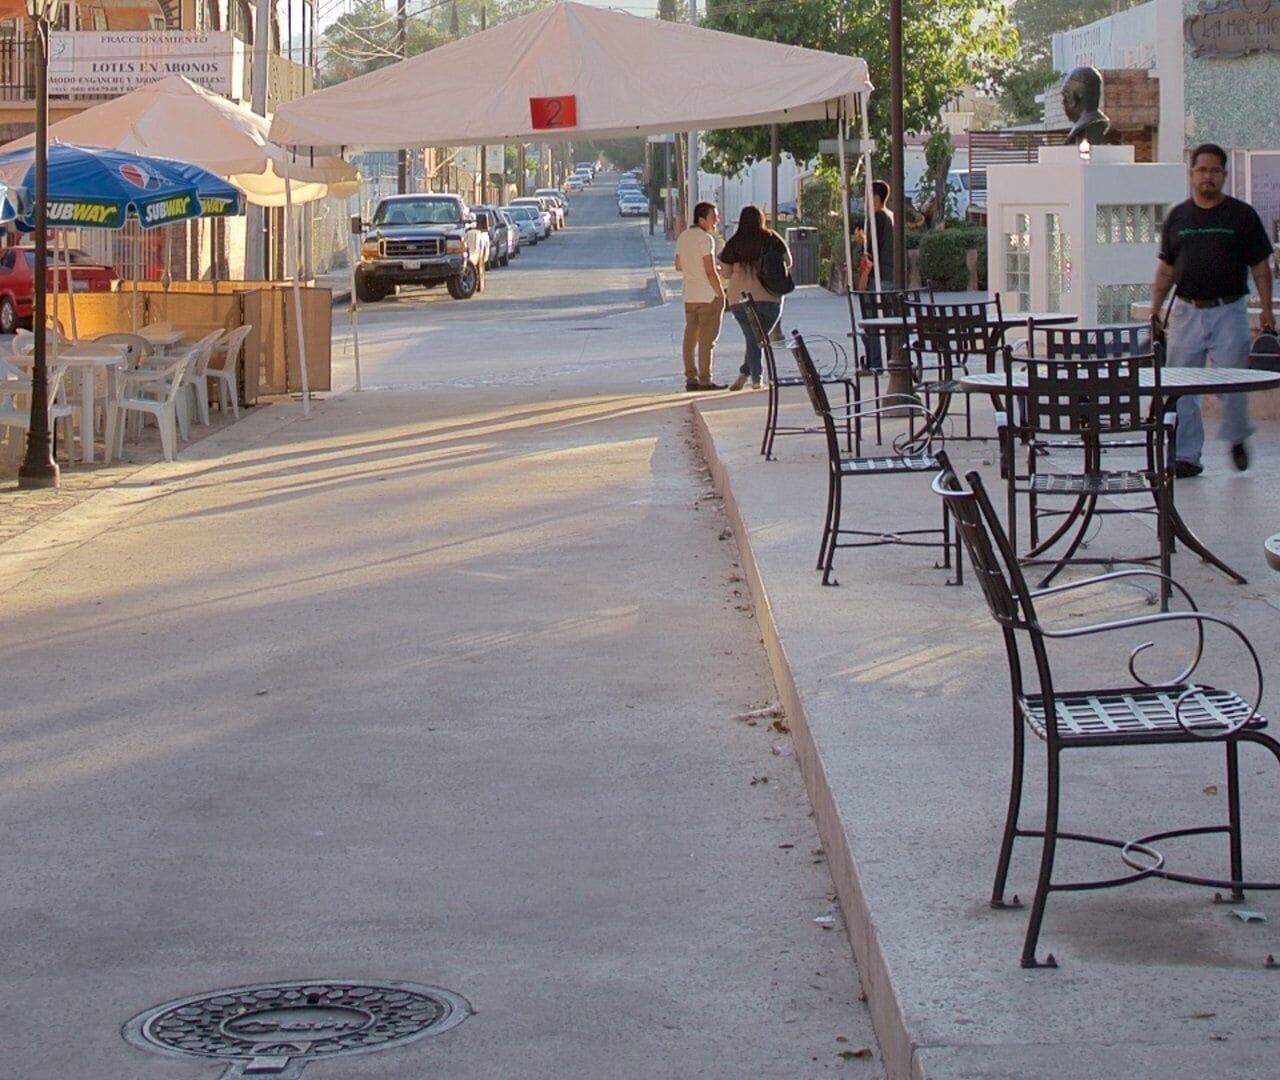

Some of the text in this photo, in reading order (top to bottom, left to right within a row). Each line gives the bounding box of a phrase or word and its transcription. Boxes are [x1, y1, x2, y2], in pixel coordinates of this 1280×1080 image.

[1201, 18, 1221, 39] LA
[100, 35, 209, 44] FRACCIONAMIENTO
[91, 62, 219, 74] LOTES EN ABONOS
[545, 99, 564, 127] 2
[145, 195, 192, 223] SUBWAY
